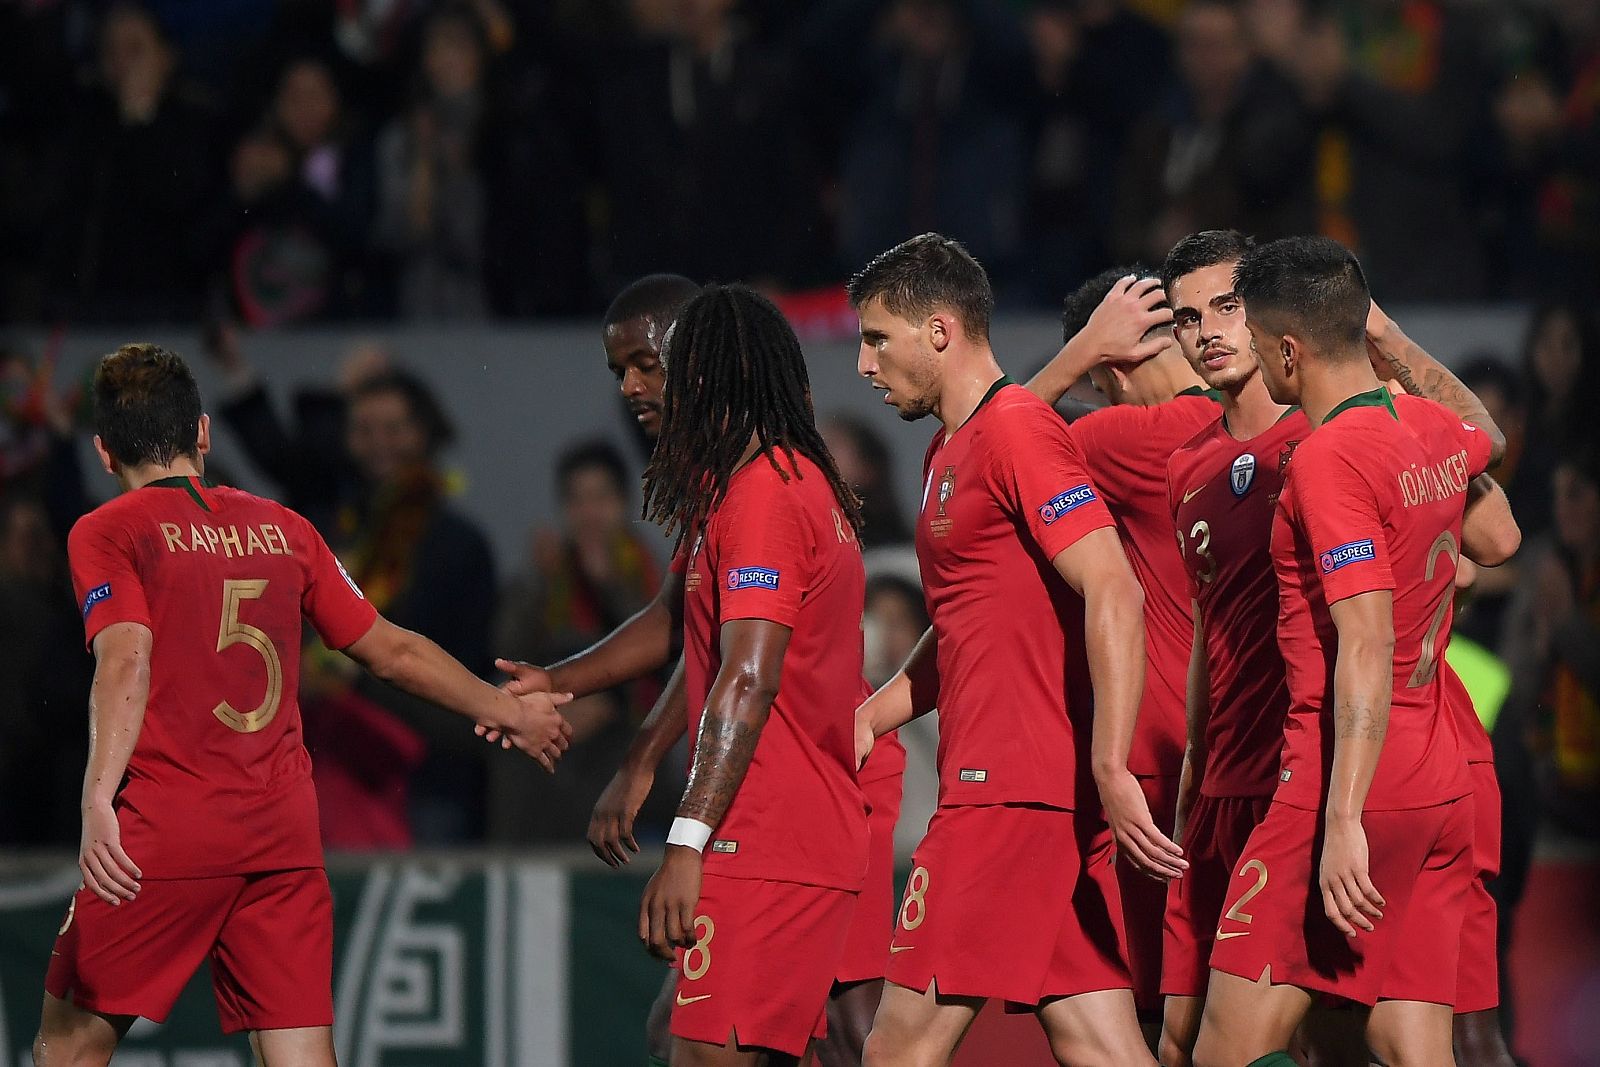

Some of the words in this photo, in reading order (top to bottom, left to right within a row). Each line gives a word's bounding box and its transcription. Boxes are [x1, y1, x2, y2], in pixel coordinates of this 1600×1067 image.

[1053, 486, 1094, 513] RESPECT
[159, 522, 294, 558] RAPHAEL
[1332, 544, 1374, 564] RESPECT
[739, 571, 779, 585] RESPECT
[212, 578, 283, 734] 5
[901, 866, 930, 931] 8
[1224, 858, 1268, 924] 2
[682, 914, 715, 981] 8
